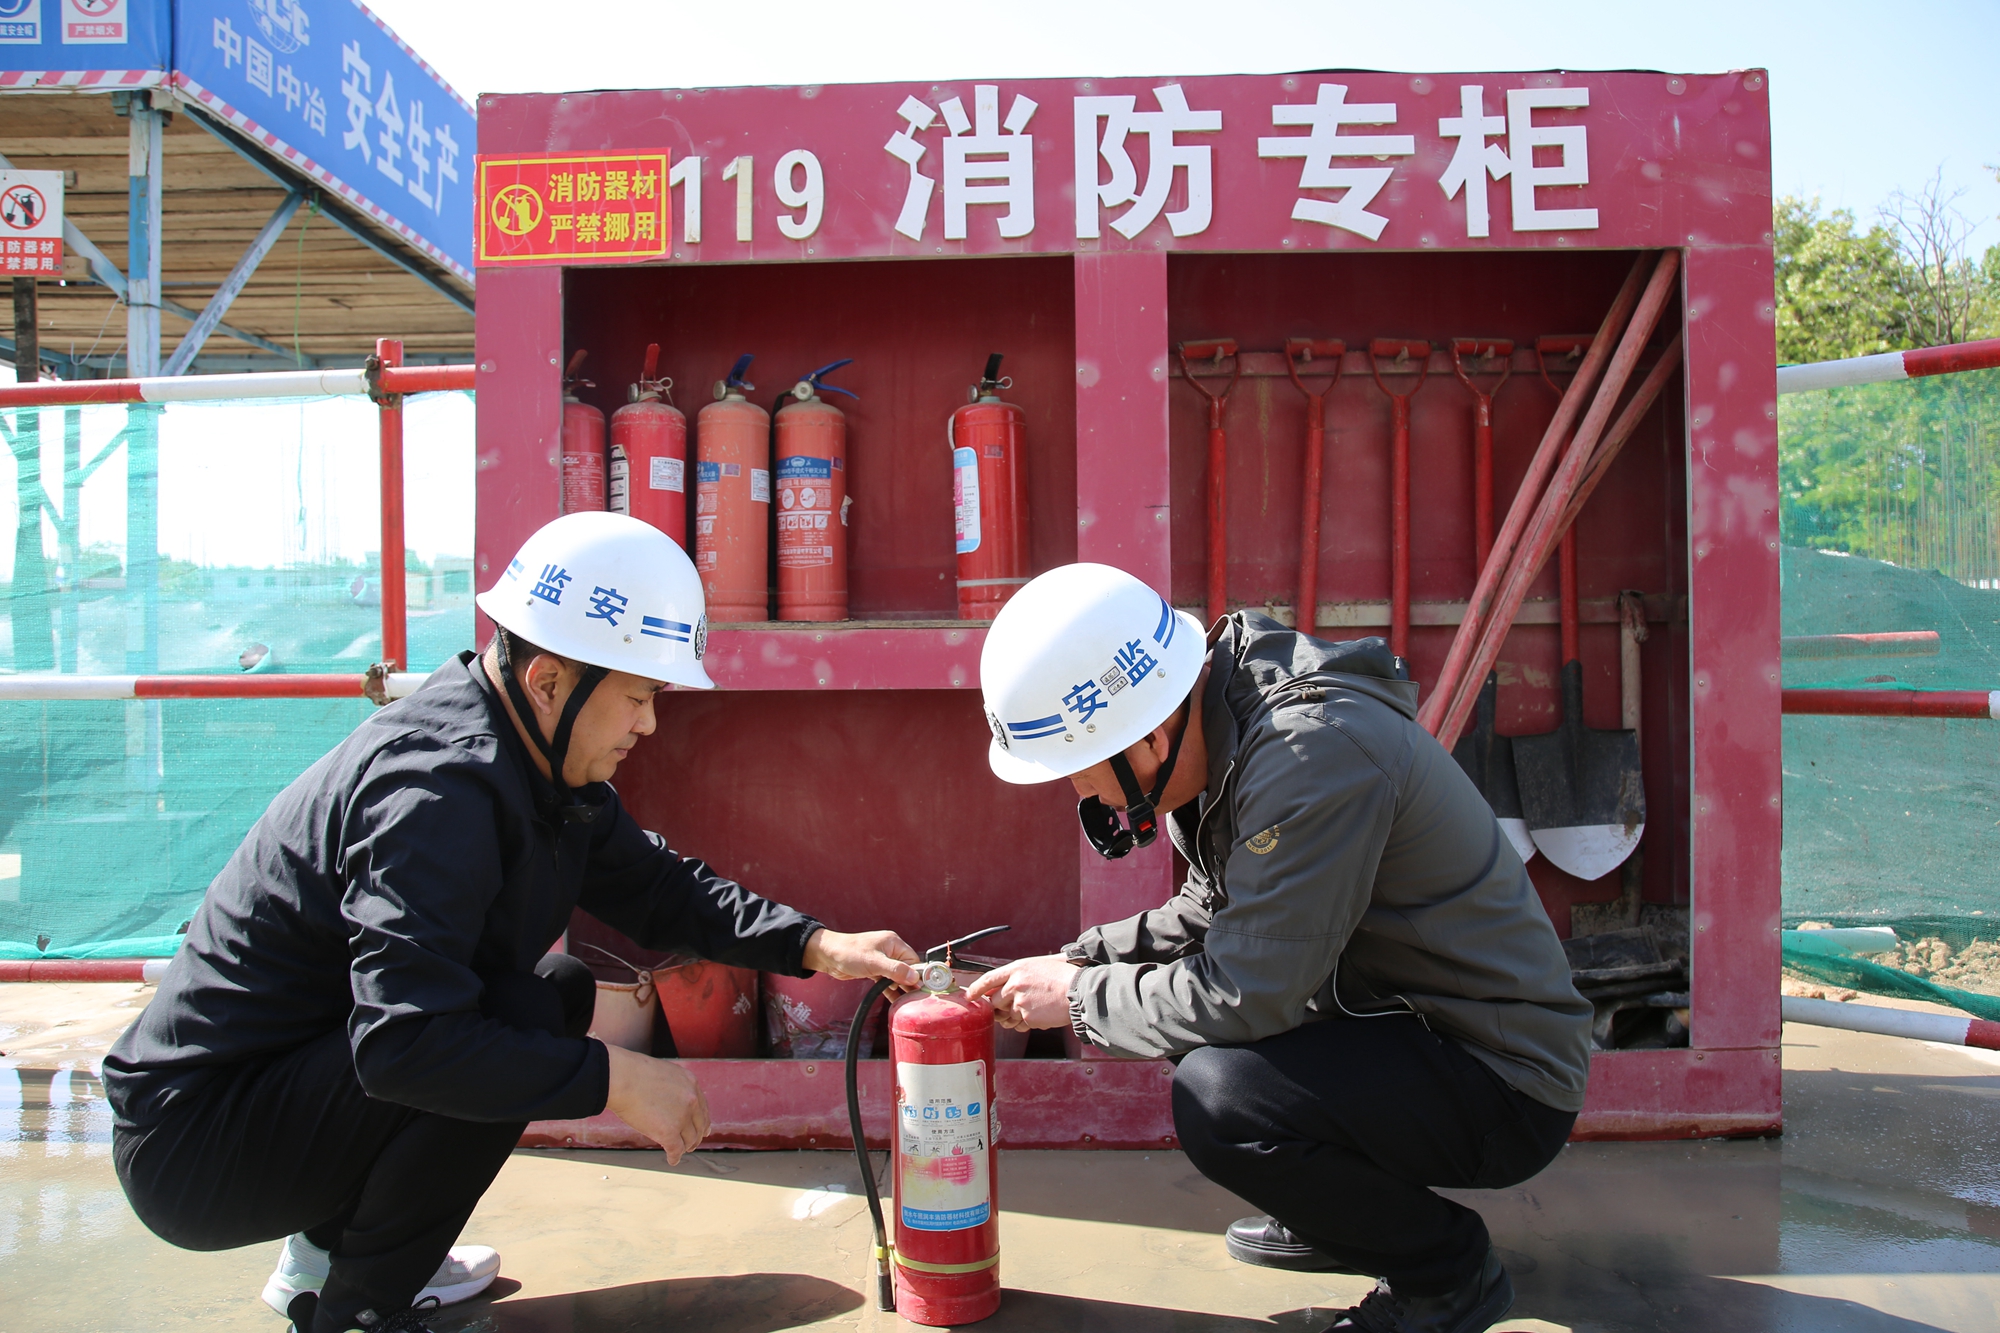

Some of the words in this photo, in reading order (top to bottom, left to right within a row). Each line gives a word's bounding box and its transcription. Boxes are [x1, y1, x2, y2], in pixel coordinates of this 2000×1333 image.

[74, 25, 116, 36] 严禁烟火
[213, 17, 328, 138] 中国中冶
[341, 39, 460, 218] 安全生产
[669, 149, 825, 243] 119
[883, 83, 1600, 242] 消防专柜
[548, 169, 658, 203] 消防器材
[547, 210, 657, 245] 严禁挪用
